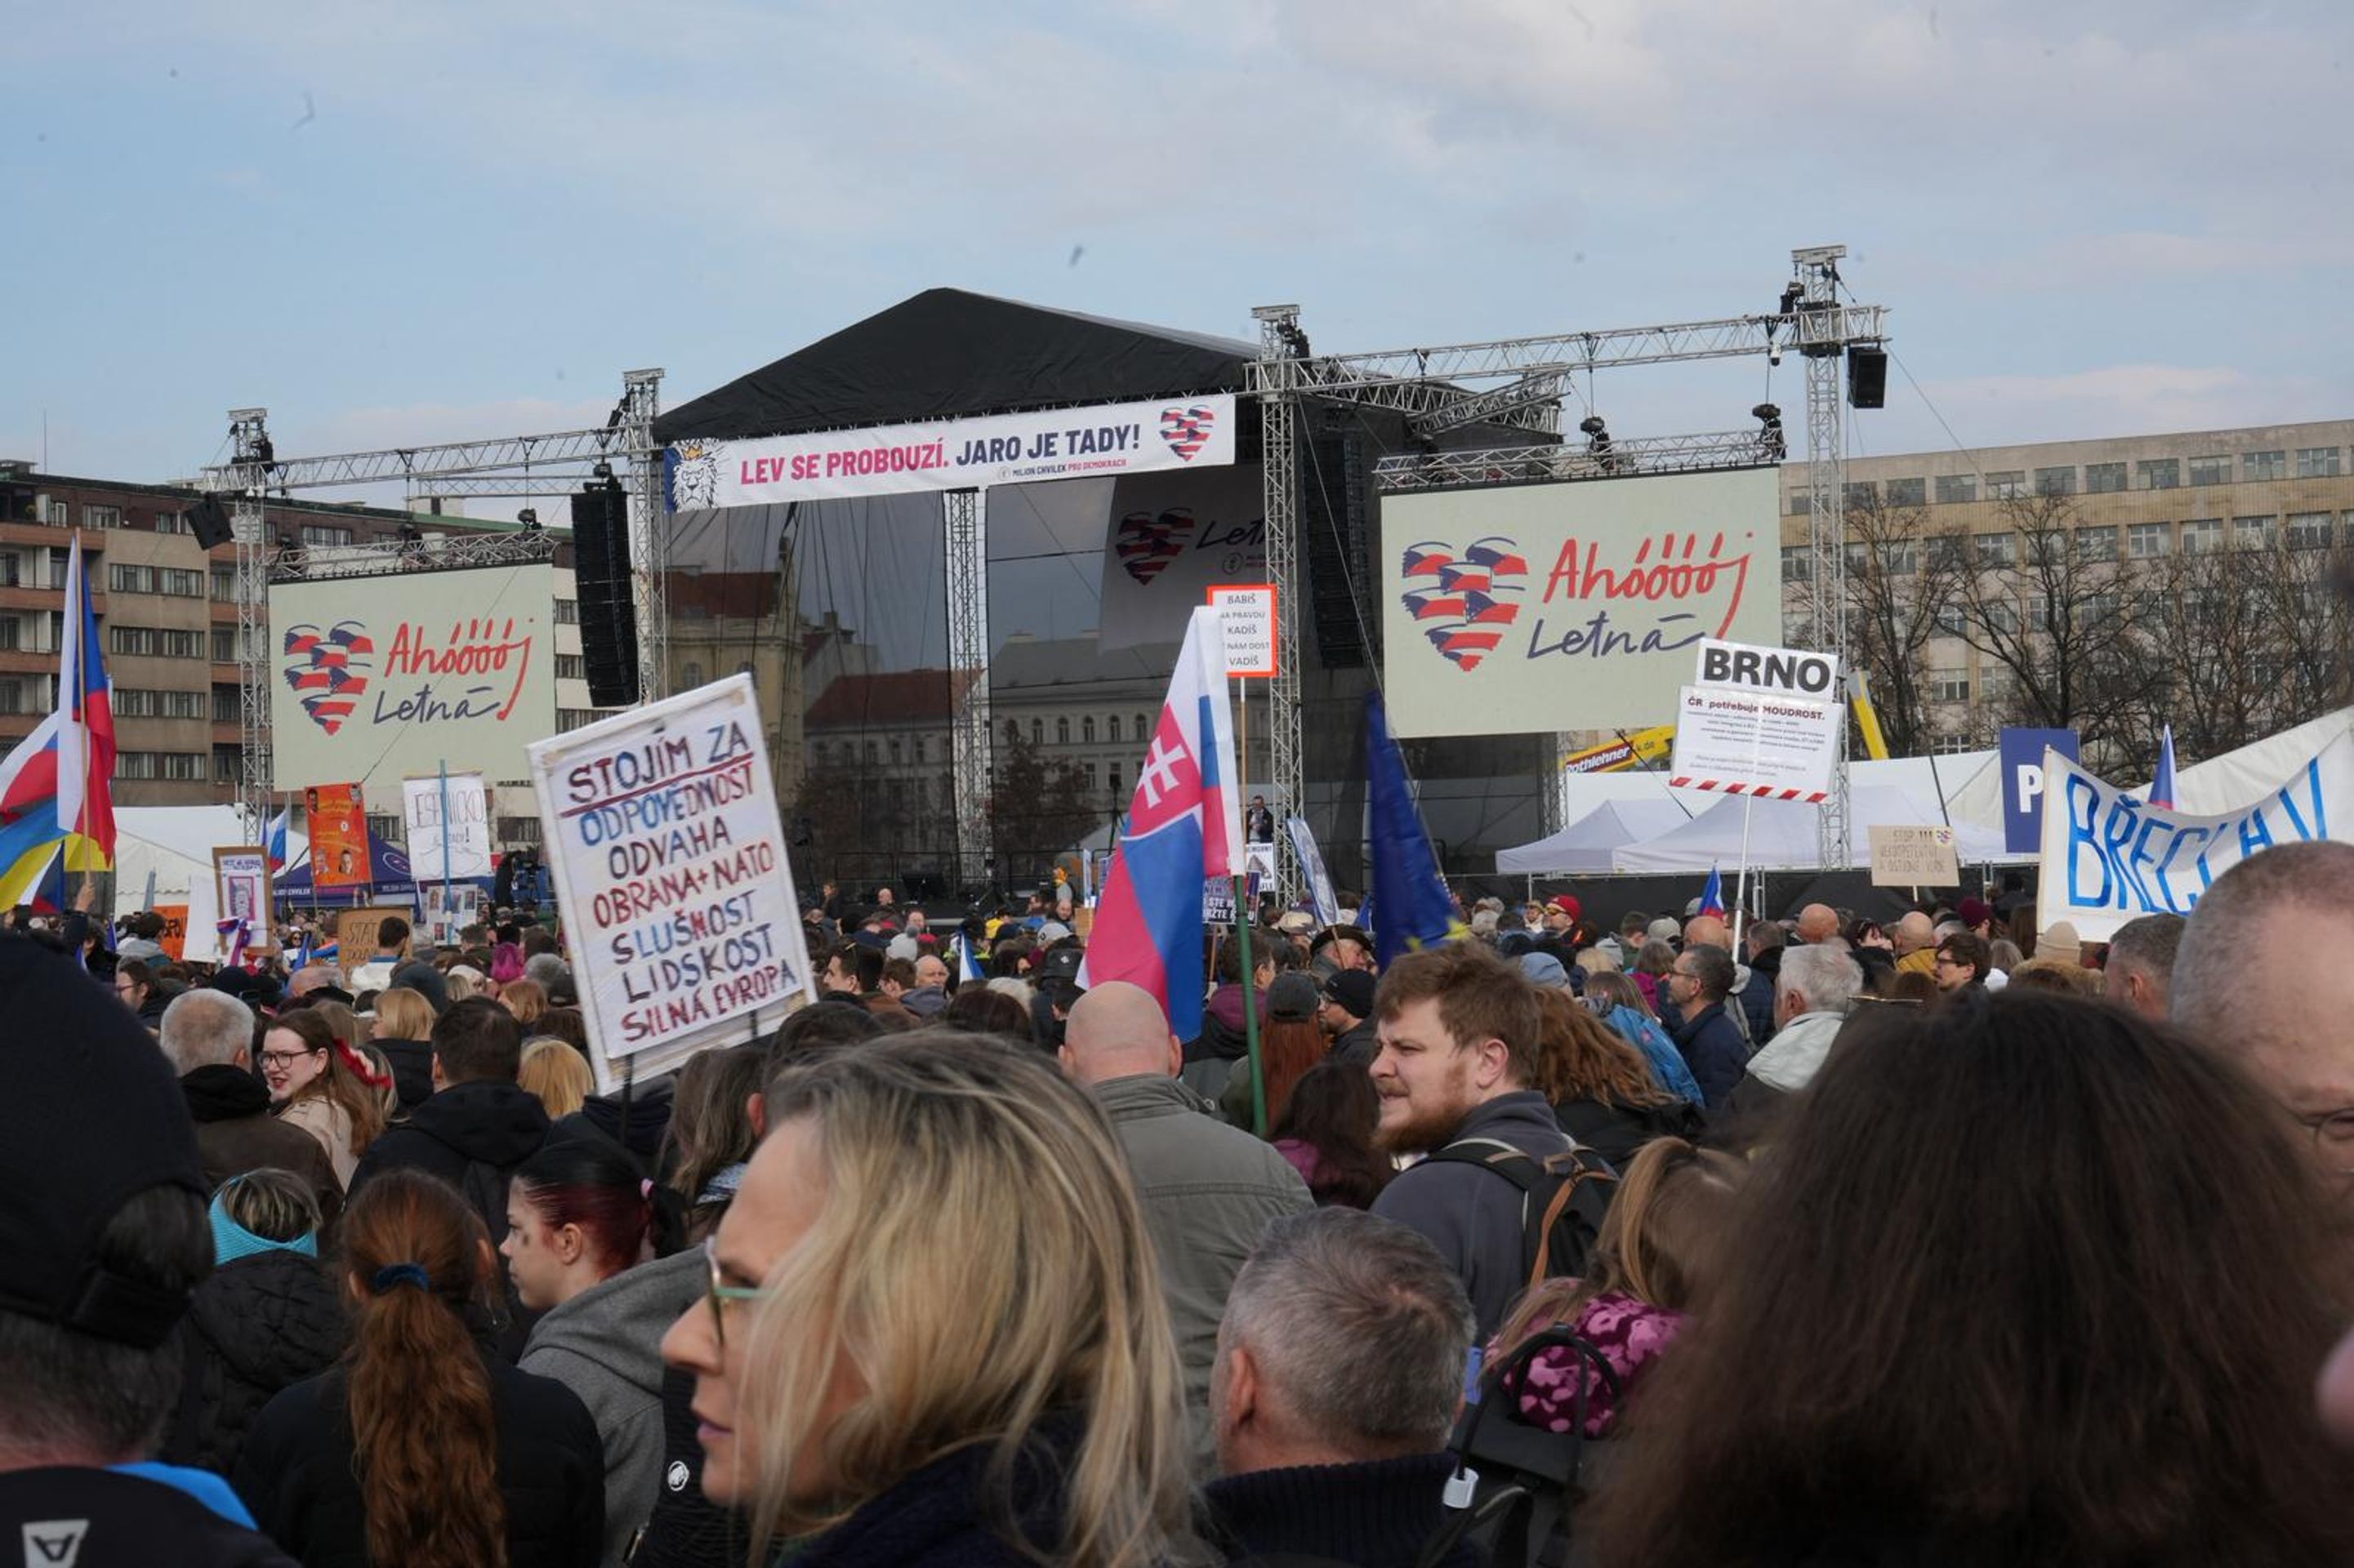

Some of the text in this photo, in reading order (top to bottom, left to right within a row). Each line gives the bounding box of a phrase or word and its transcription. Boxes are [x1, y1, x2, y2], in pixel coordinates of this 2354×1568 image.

[741, 424, 1140, 485] LEV SE PROBOUZÍ. JARO JE TADY!
[1037, 464, 1067, 475] CHVILEK
[1068, 462, 1082, 471] PRO
[1527, 611, 1706, 660] Letná
[1703, 648, 1831, 693] BRNO
[372, 684, 501, 724] Letná
[1709, 700, 1759, 714] potřebuje
[1763, 706, 1826, 720] MOUDROST.
[568, 720, 750, 804] STOJÍM ZA
[579, 761, 754, 847] ODPOVĚDNOST
[609, 816, 732, 880] ODVAHA
[610, 889, 756, 965] SLUŠNOST
[622, 922, 773, 1004] LIDSKOST
[620, 958, 798, 1043] SILNÁ EVROPA
